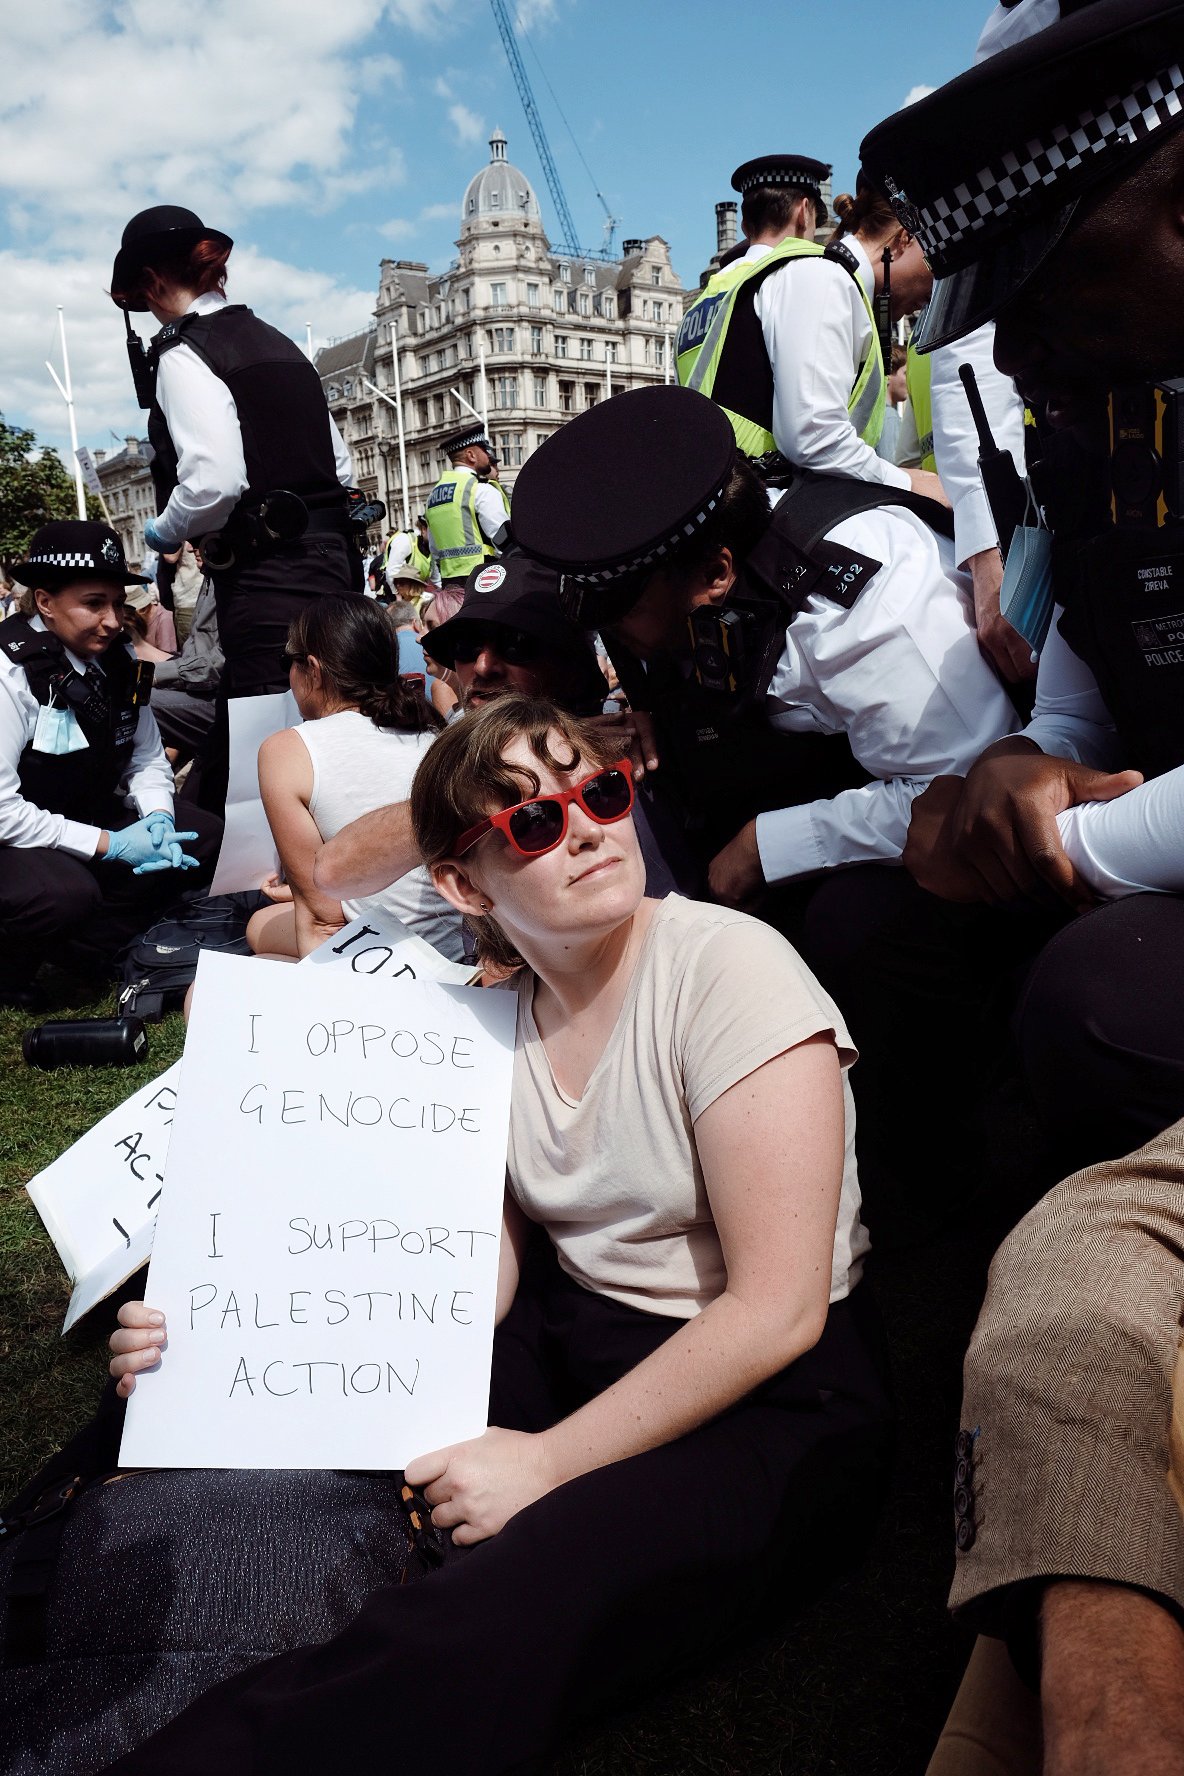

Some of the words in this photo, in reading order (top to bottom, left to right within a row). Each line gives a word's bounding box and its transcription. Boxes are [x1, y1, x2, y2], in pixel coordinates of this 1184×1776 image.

[1137, 565, 1173, 580] CONSTABLE
[1144, 649, 1184, 667] POLICE
[247, 1014, 263, 1054] I
[306, 1019, 476, 1069] OPPOSE
[239, 1083, 482, 1133] GENOCIDE
[207, 1213, 224, 1259] I
[287, 1217, 497, 1258] SUPPORT
[188, 1283, 474, 1331] PALESTINE
[228, 1356, 421, 1399] ACTION
